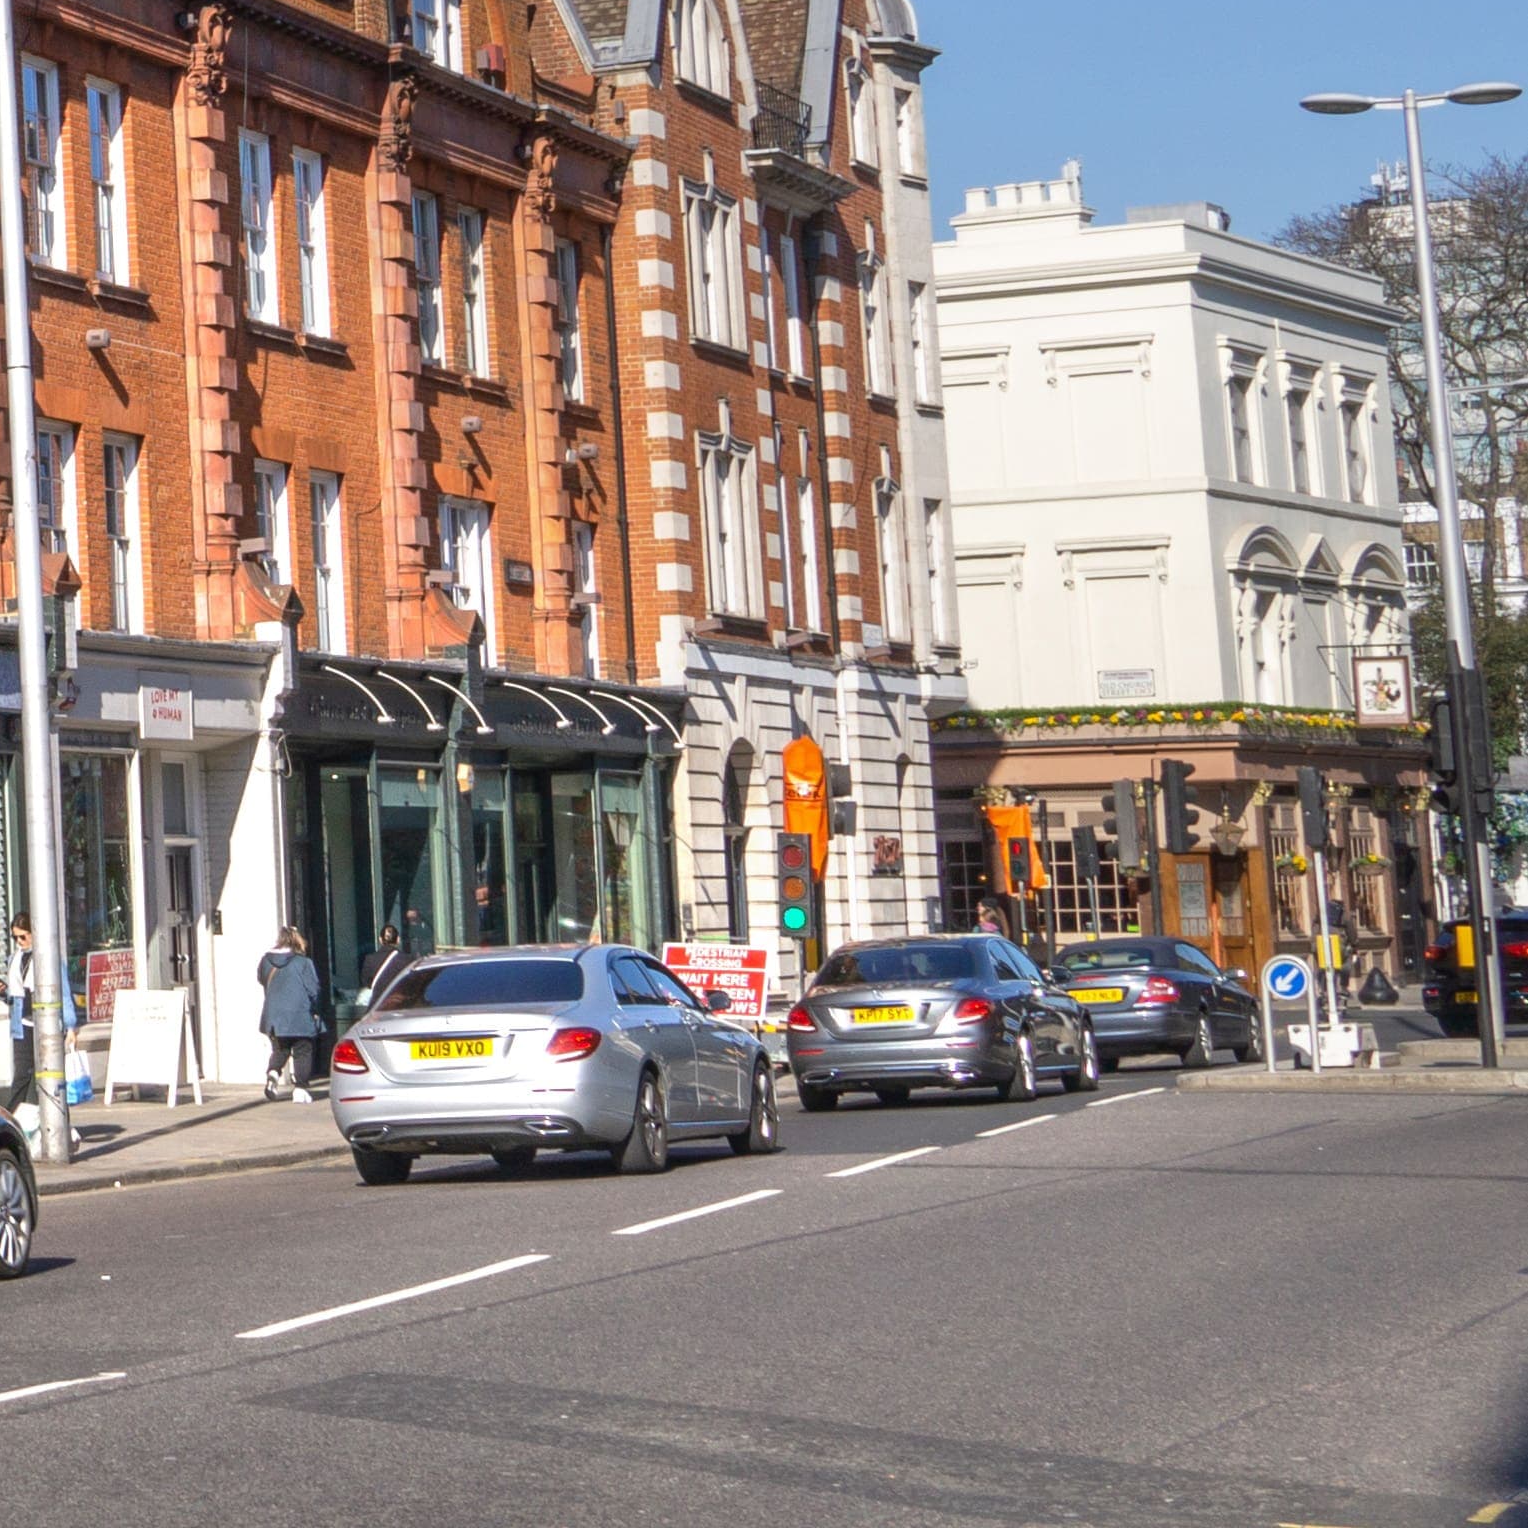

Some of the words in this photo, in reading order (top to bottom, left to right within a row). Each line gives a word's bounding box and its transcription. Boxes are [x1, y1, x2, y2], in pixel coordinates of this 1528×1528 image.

[150, 689, 168, 704] LOVE
[168, 688, 180, 701] MY
[689, 958, 743, 969] CROSSING
[712, 973, 750, 987] HERE
[418, 1042, 451, 1057] KU19
